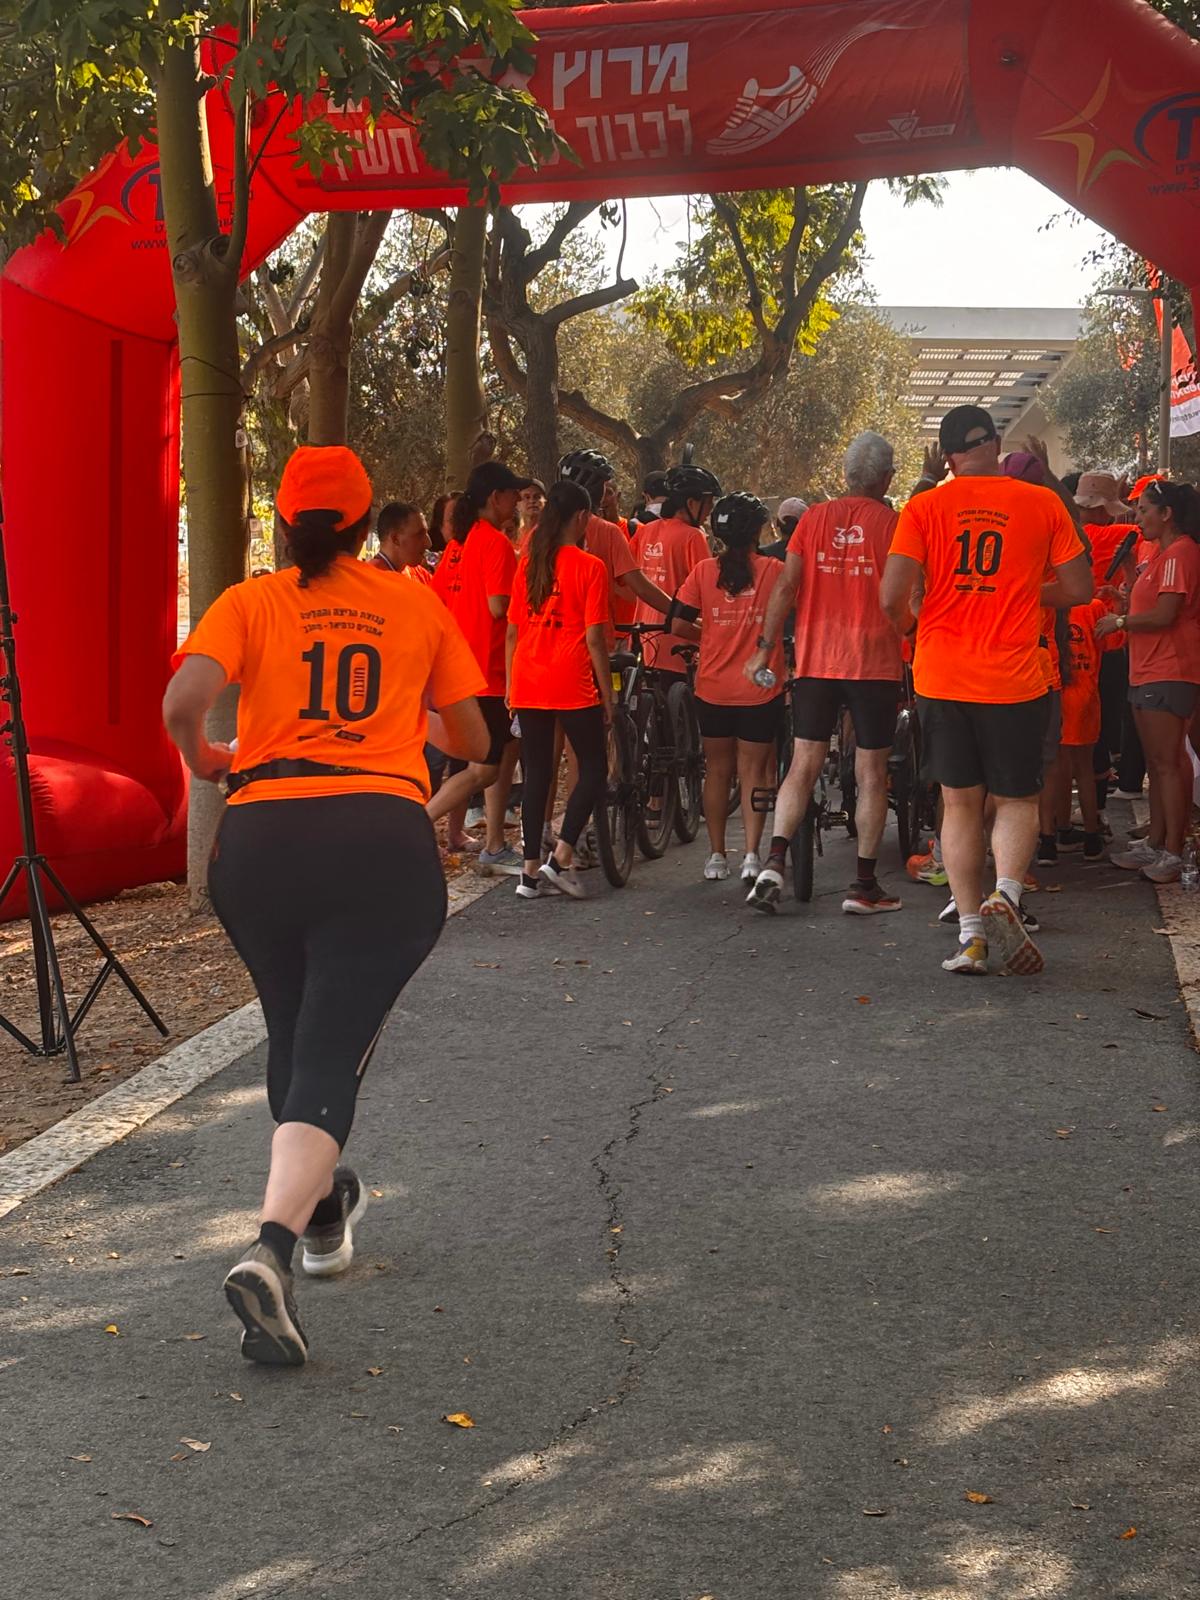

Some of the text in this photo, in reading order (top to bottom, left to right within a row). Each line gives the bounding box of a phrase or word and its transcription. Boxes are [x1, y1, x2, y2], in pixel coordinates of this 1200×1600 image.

[553, 42, 688, 111] מרוץ
[575, 103, 693, 163] לכבוד
[954, 529, 1003, 576] 10
[298, 640, 382, 723] 10
